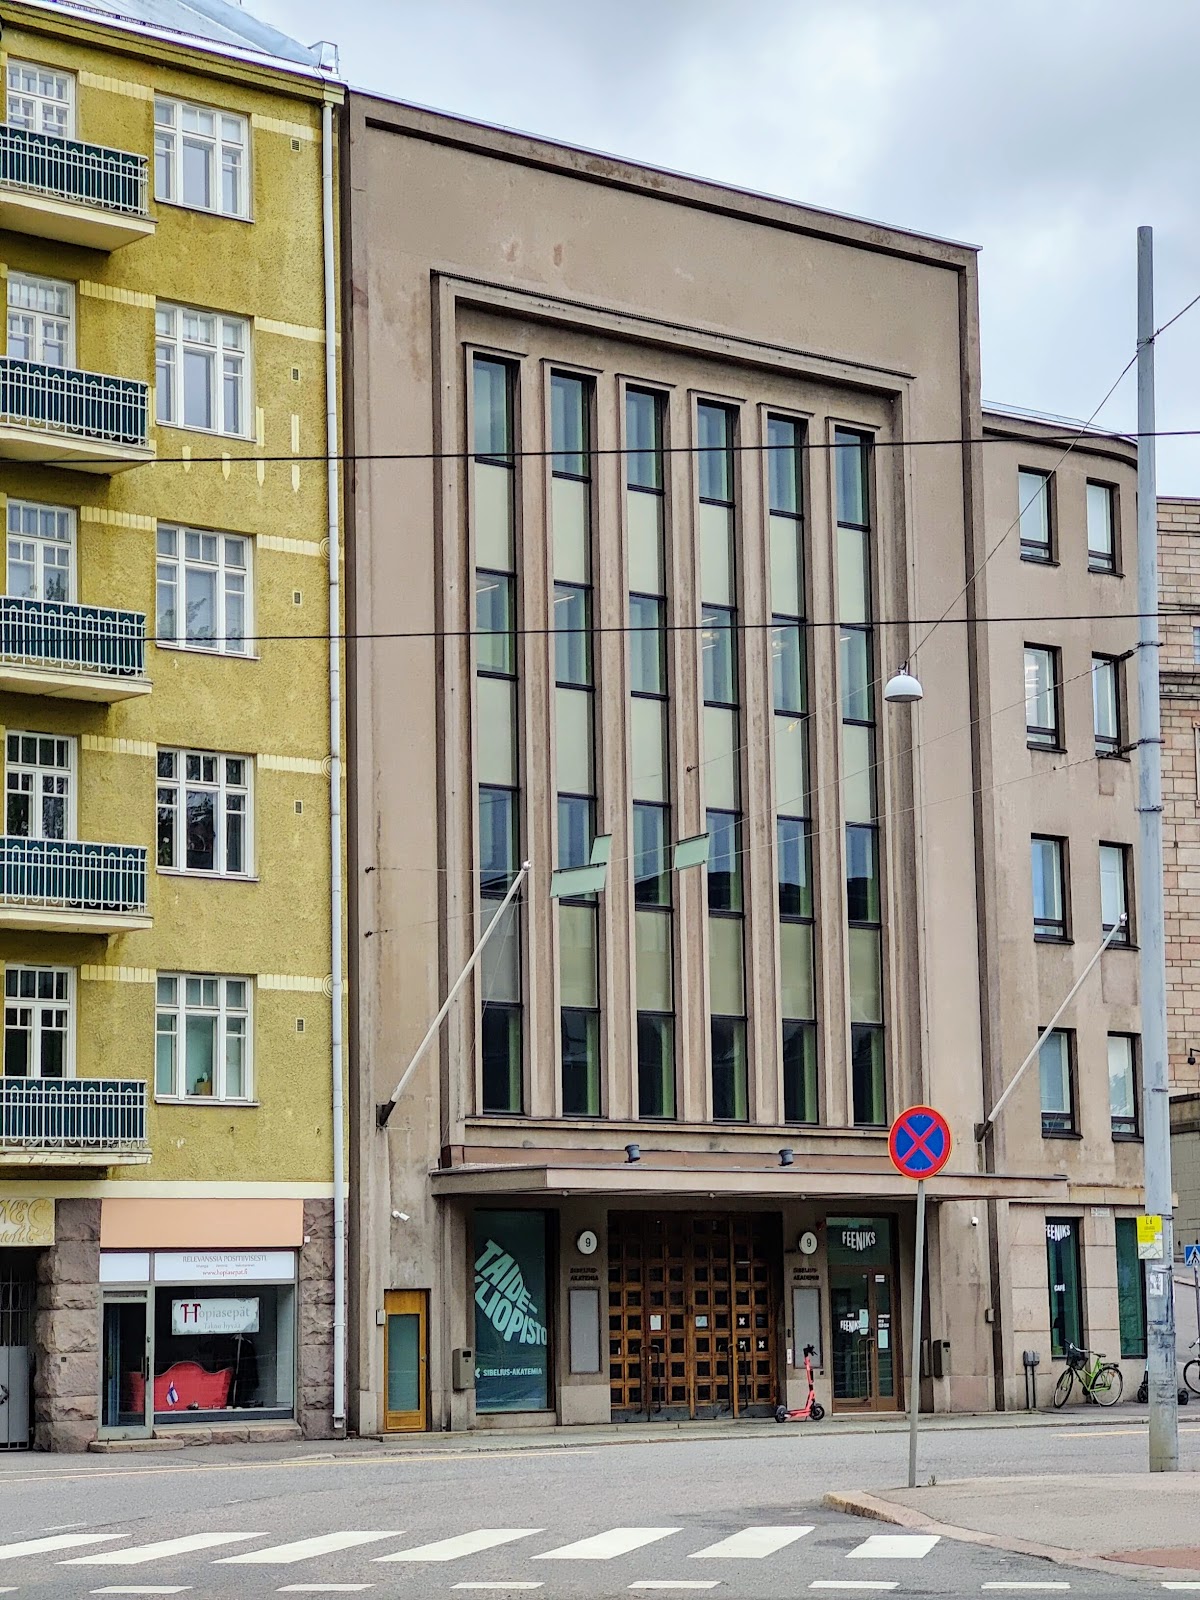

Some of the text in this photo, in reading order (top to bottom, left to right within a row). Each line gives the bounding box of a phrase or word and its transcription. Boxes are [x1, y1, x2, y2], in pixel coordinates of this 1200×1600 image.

[585, 1237, 591, 1247] 9
[806, 1238, 812, 1248] 9
[842, 1231, 876, 1251] FEENIKS
[475, 1239, 538, 1314] TAIDE-
[180, 1304, 250, 1323] Hopiasepät
[483, 1367, 542, 1377] SIBELIUS-AKATEMIA
